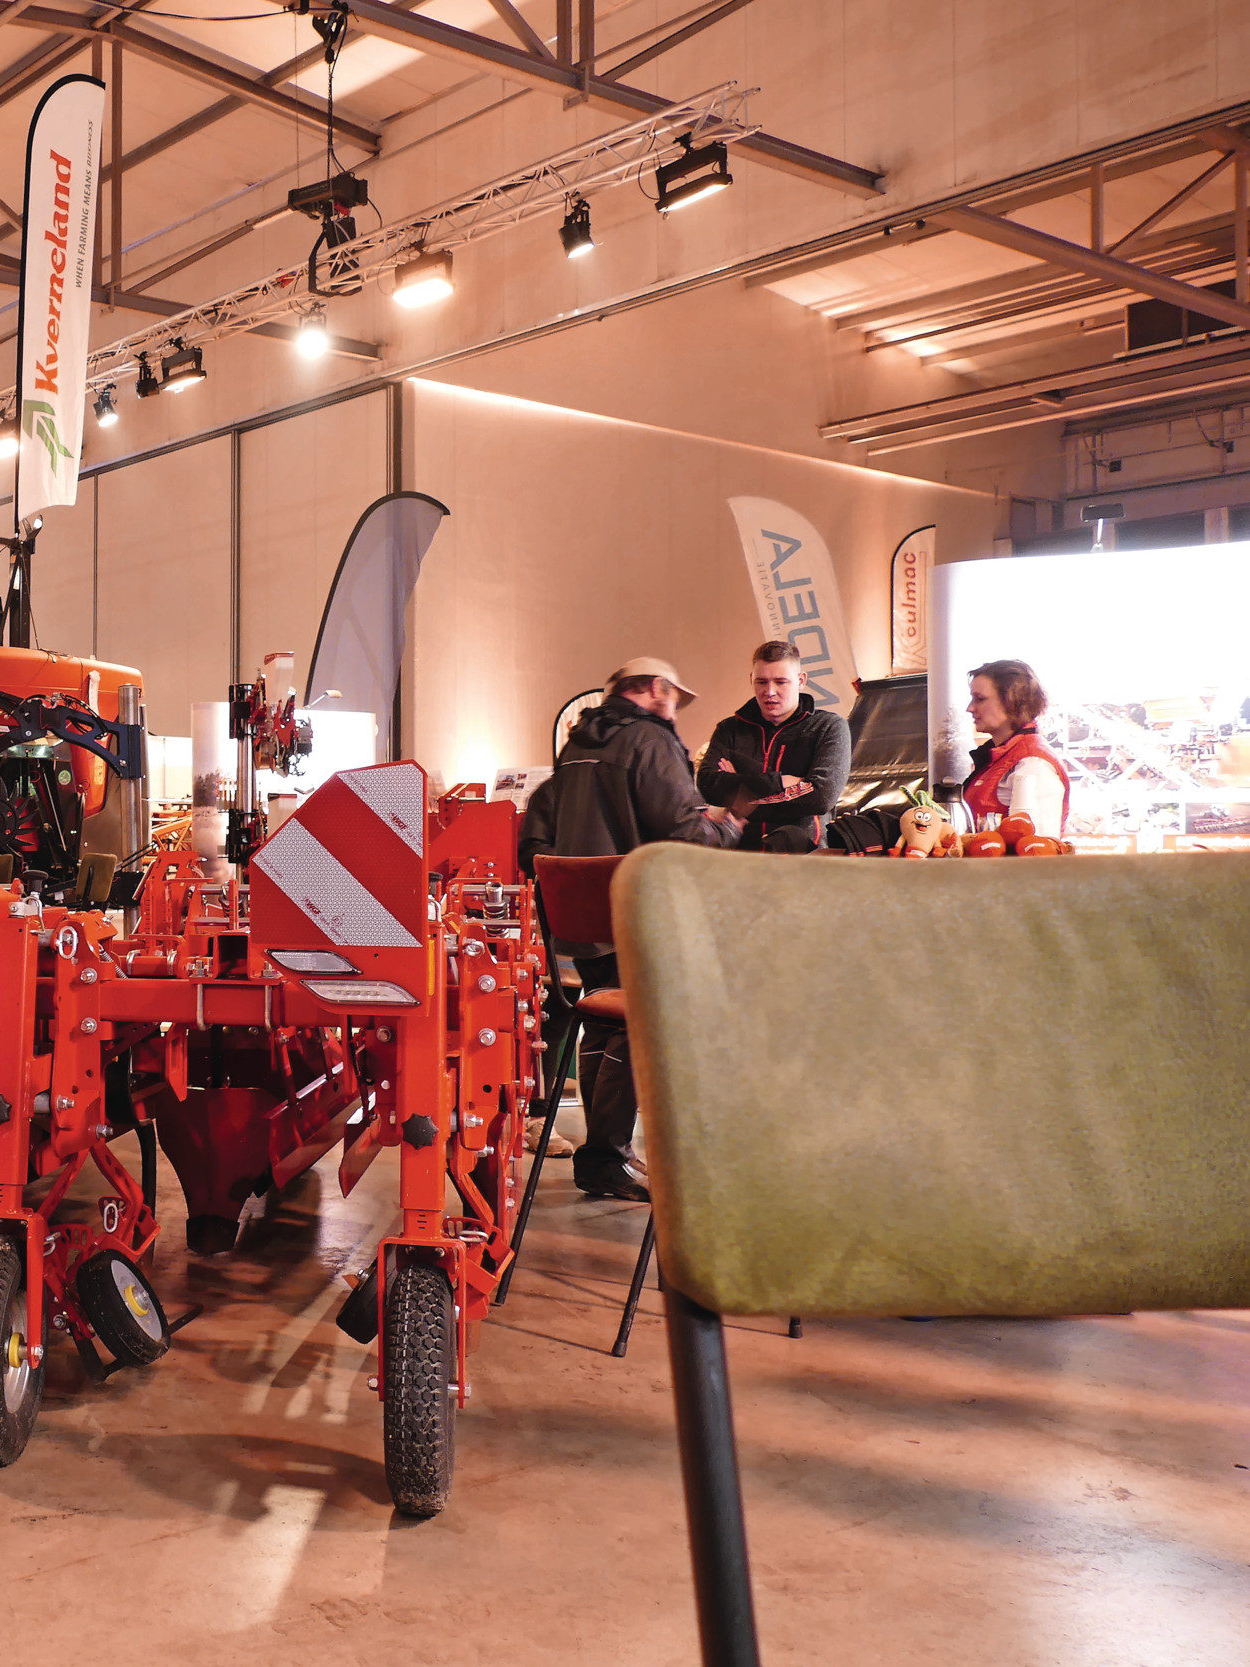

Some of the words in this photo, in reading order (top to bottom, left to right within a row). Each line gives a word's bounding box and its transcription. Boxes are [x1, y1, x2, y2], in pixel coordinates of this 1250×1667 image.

[83, 169, 92, 206] MEANS
[78, 207, 90, 256] FARMING
[34, 148, 72, 394] Kverneland
[75, 257, 85, 288] WHEN
[902, 552, 917, 638] culmac
